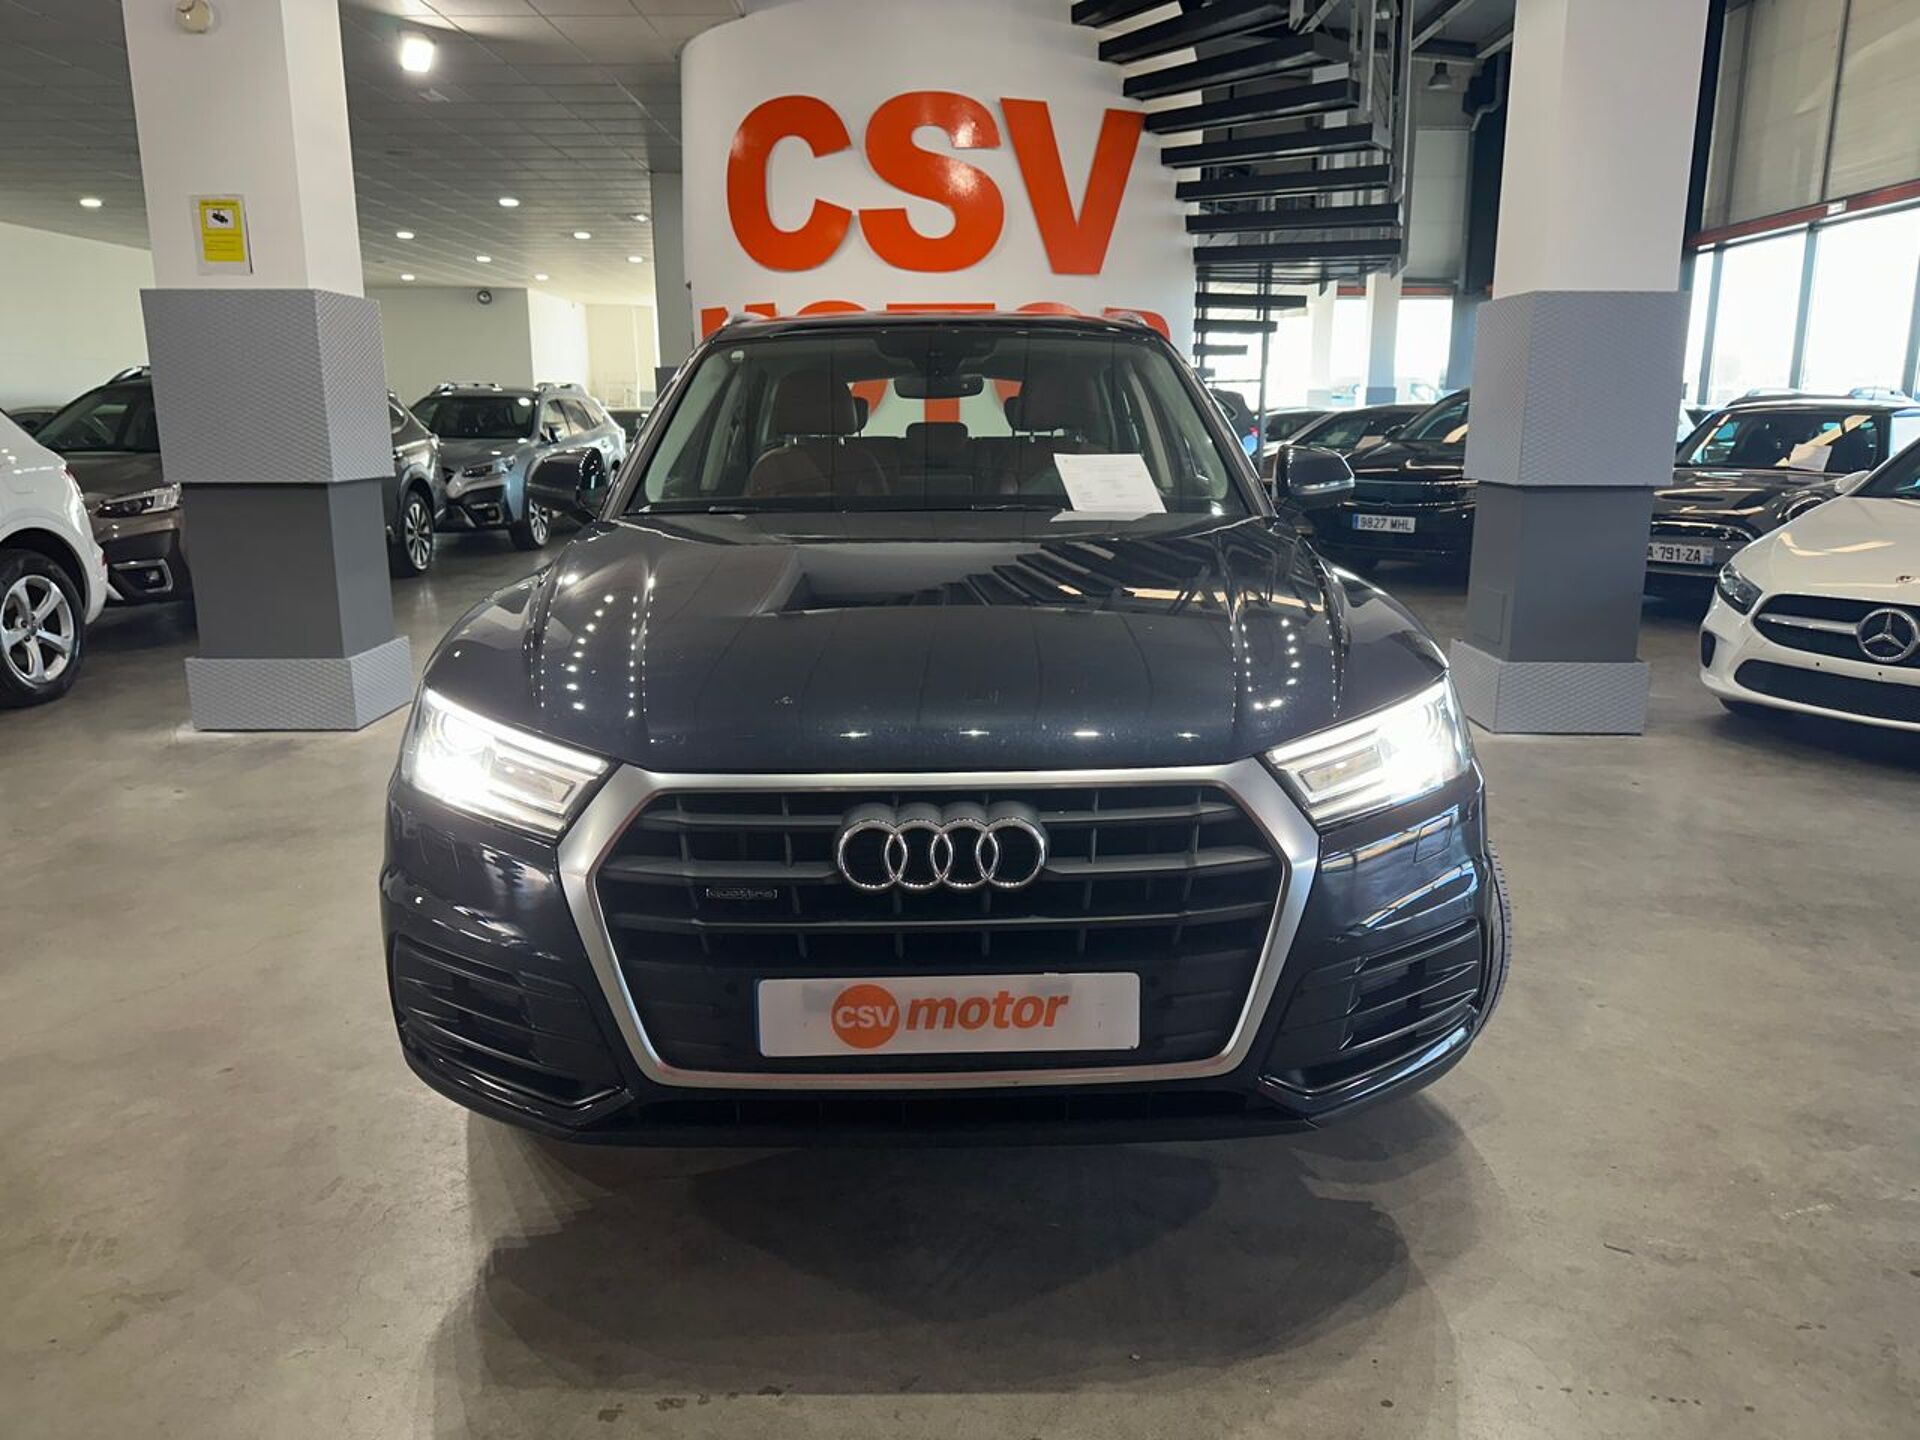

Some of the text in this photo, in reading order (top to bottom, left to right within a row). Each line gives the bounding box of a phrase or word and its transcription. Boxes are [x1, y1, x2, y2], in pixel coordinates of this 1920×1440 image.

[727, 91, 1144, 275] CSV
[1360, 516, 1412, 531] 9827 MHL
[836, 990, 1068, 1030] CSV motor
